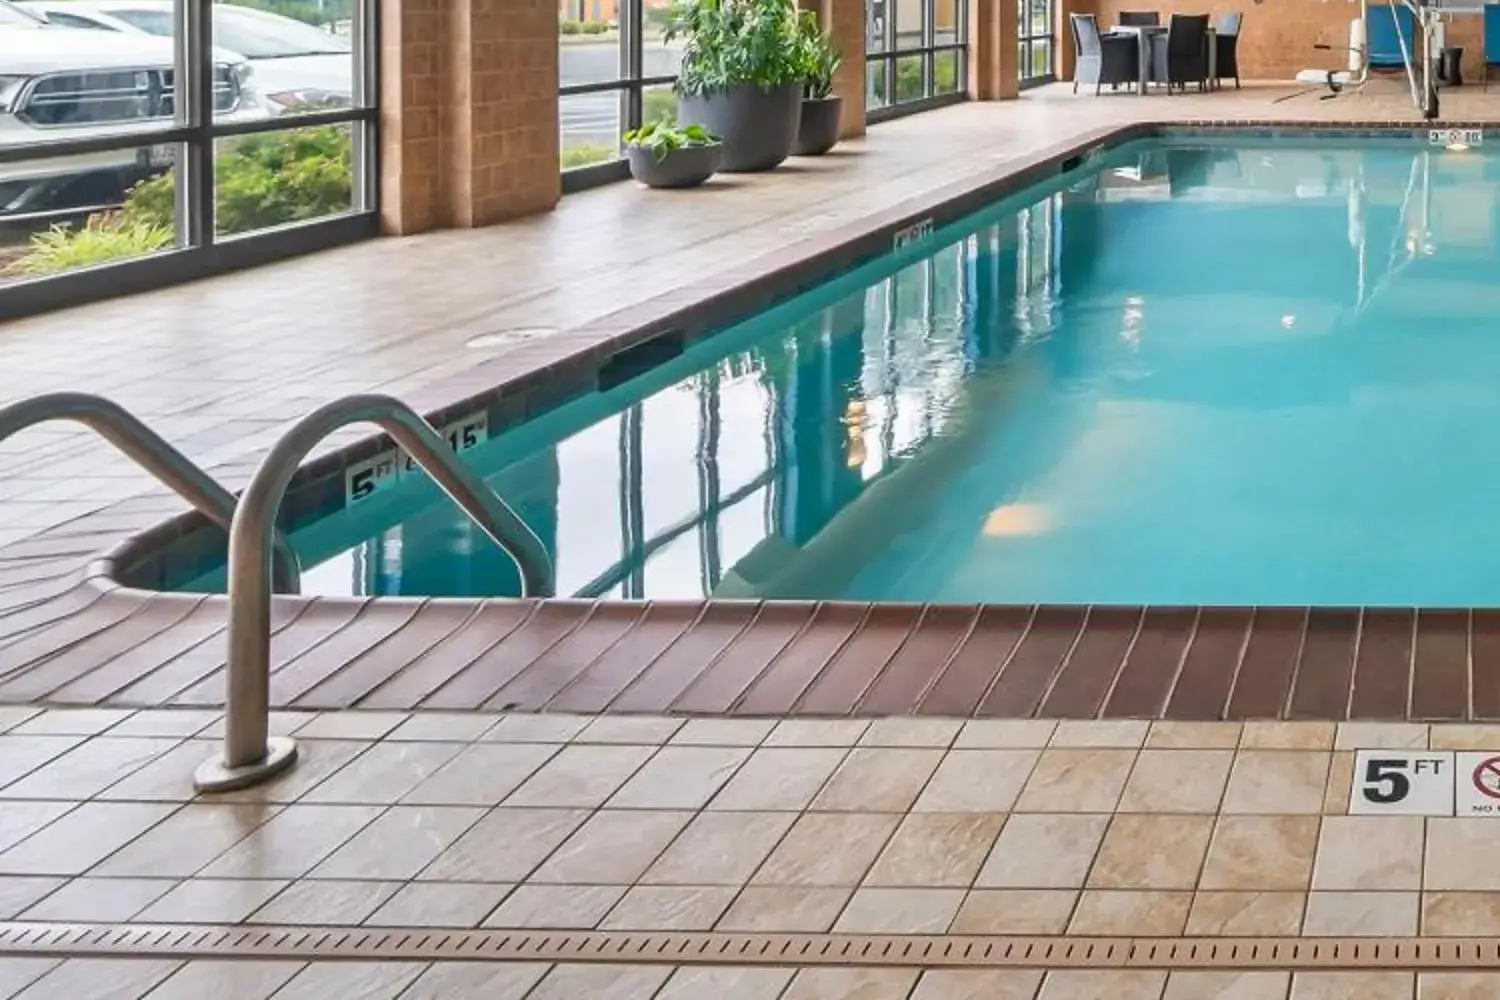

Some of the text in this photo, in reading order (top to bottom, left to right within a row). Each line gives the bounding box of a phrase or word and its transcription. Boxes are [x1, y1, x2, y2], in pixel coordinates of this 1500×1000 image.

[352, 467, 374, 500] 5
[1363, 759, 1444, 804] 5 FT
